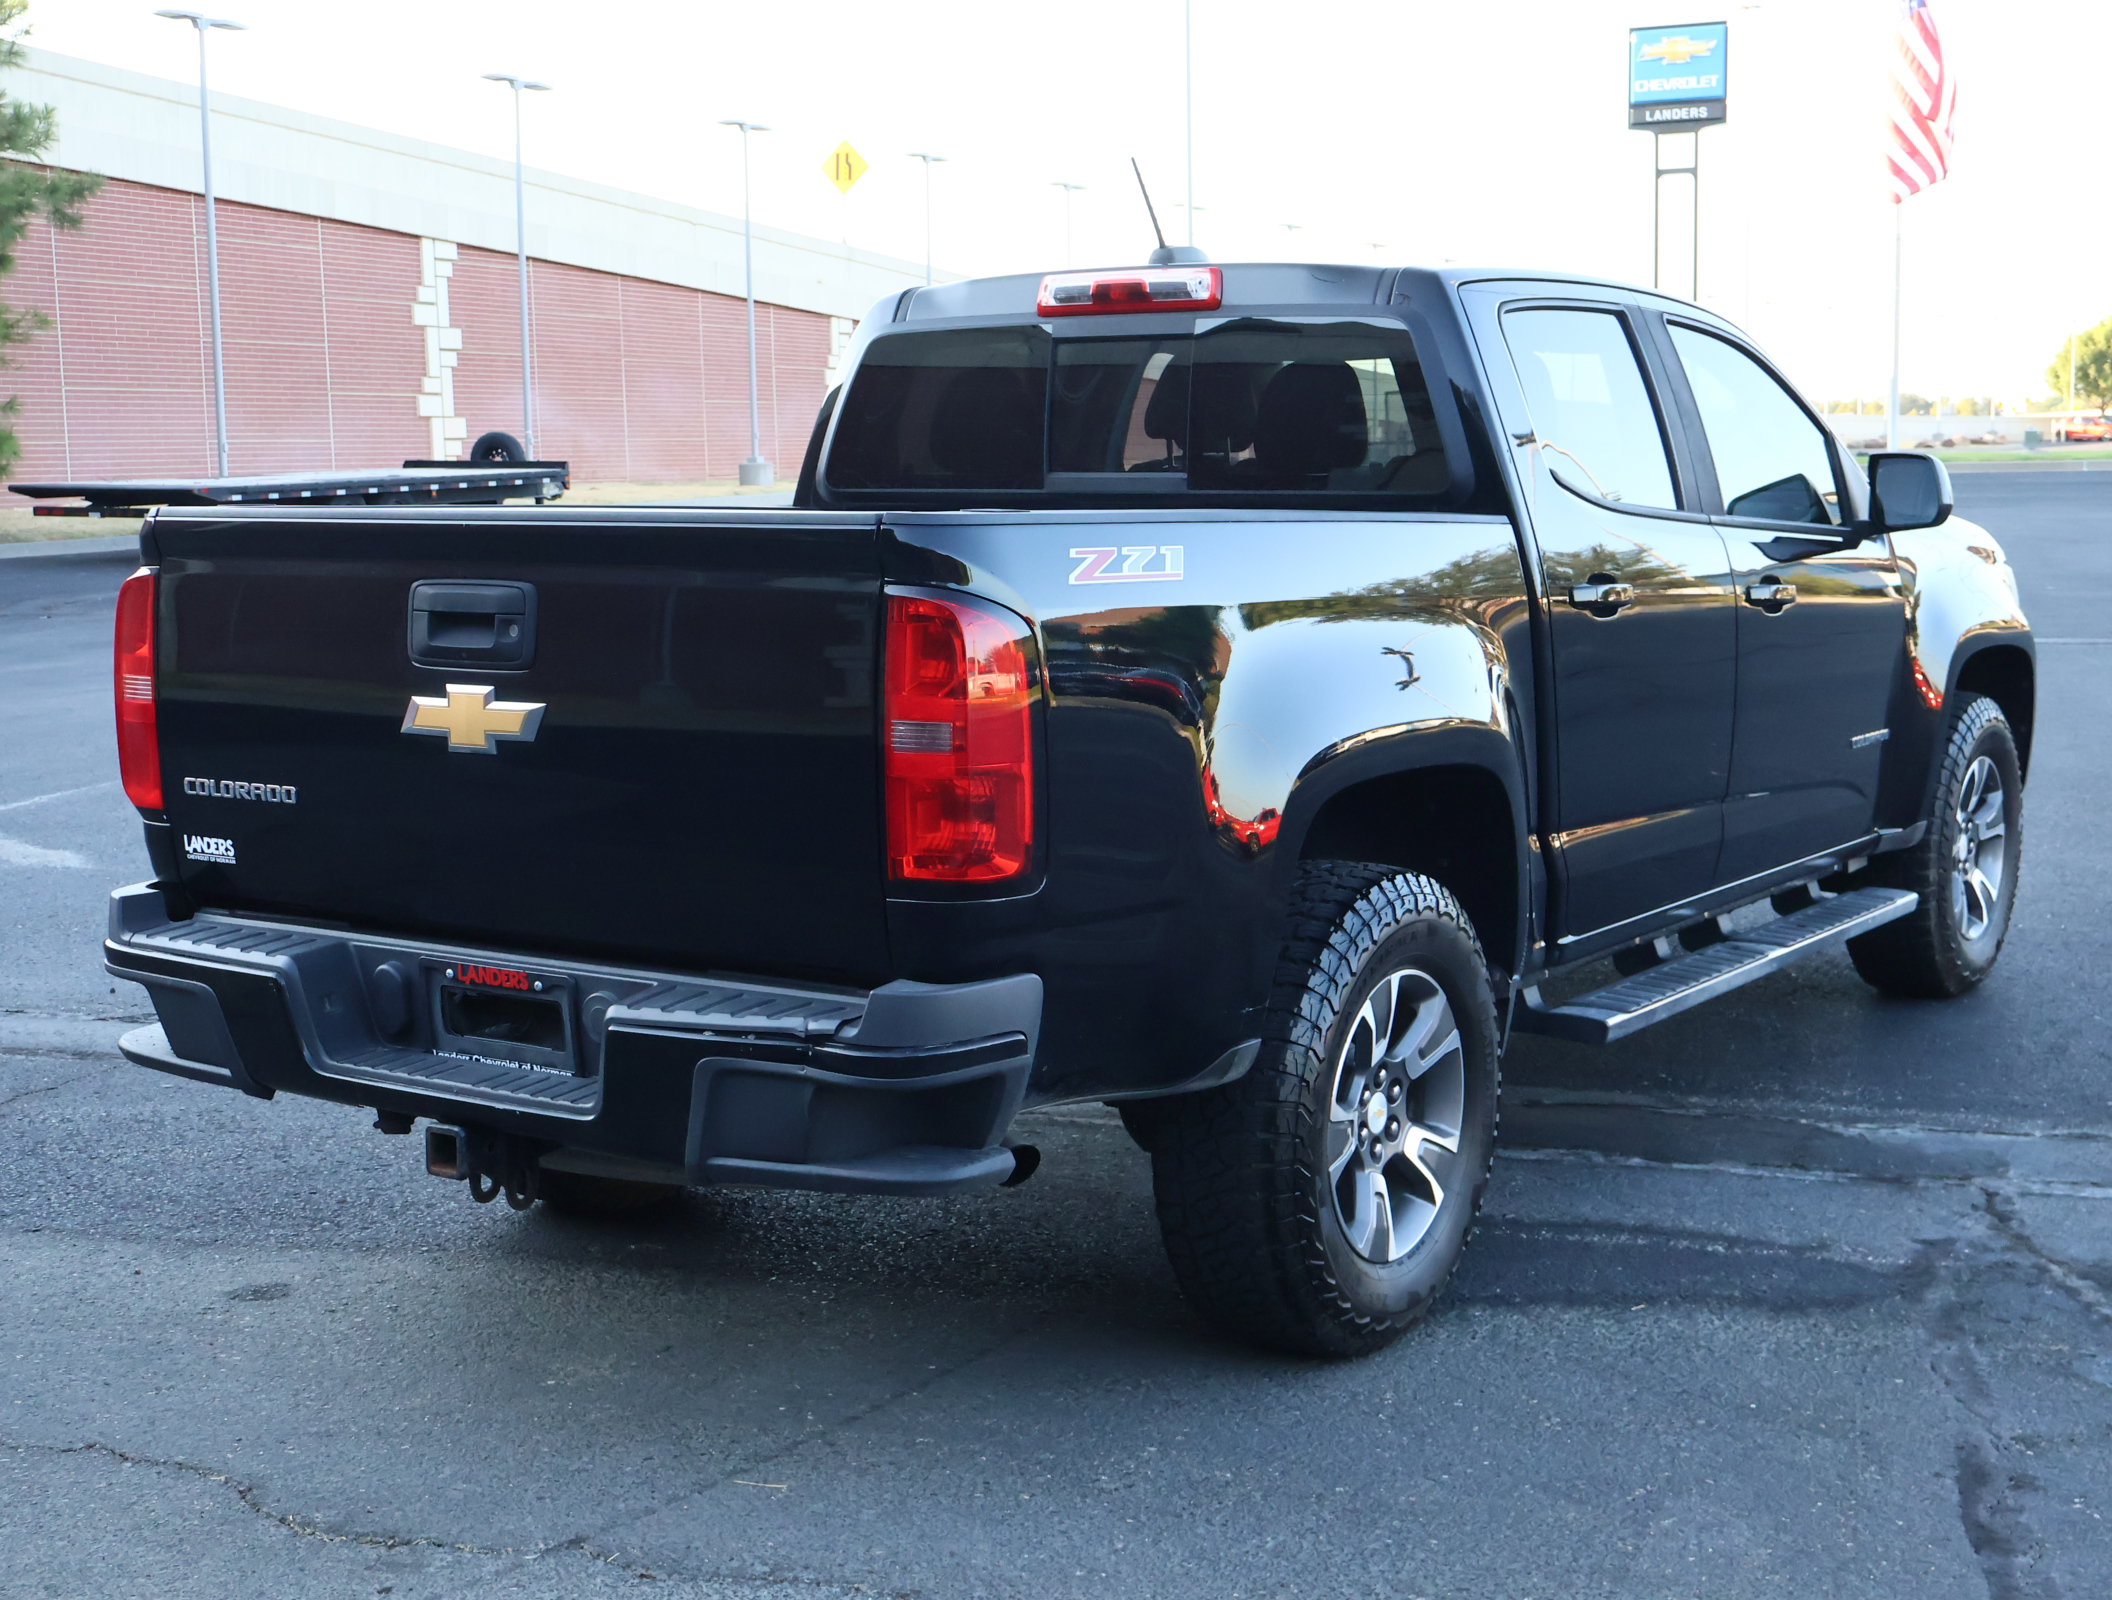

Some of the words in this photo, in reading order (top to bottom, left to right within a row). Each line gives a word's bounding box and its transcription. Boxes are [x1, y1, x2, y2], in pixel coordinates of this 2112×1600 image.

[1634, 74, 1719, 93] CHEVROLET
[1645, 106, 1708, 122] LANDERS
[1068, 545, 1184, 585] Z71
[183, 777, 297, 804] COLORADO
[183, 834, 235, 857] LANDERS
[458, 964, 529, 990] LANDERS
